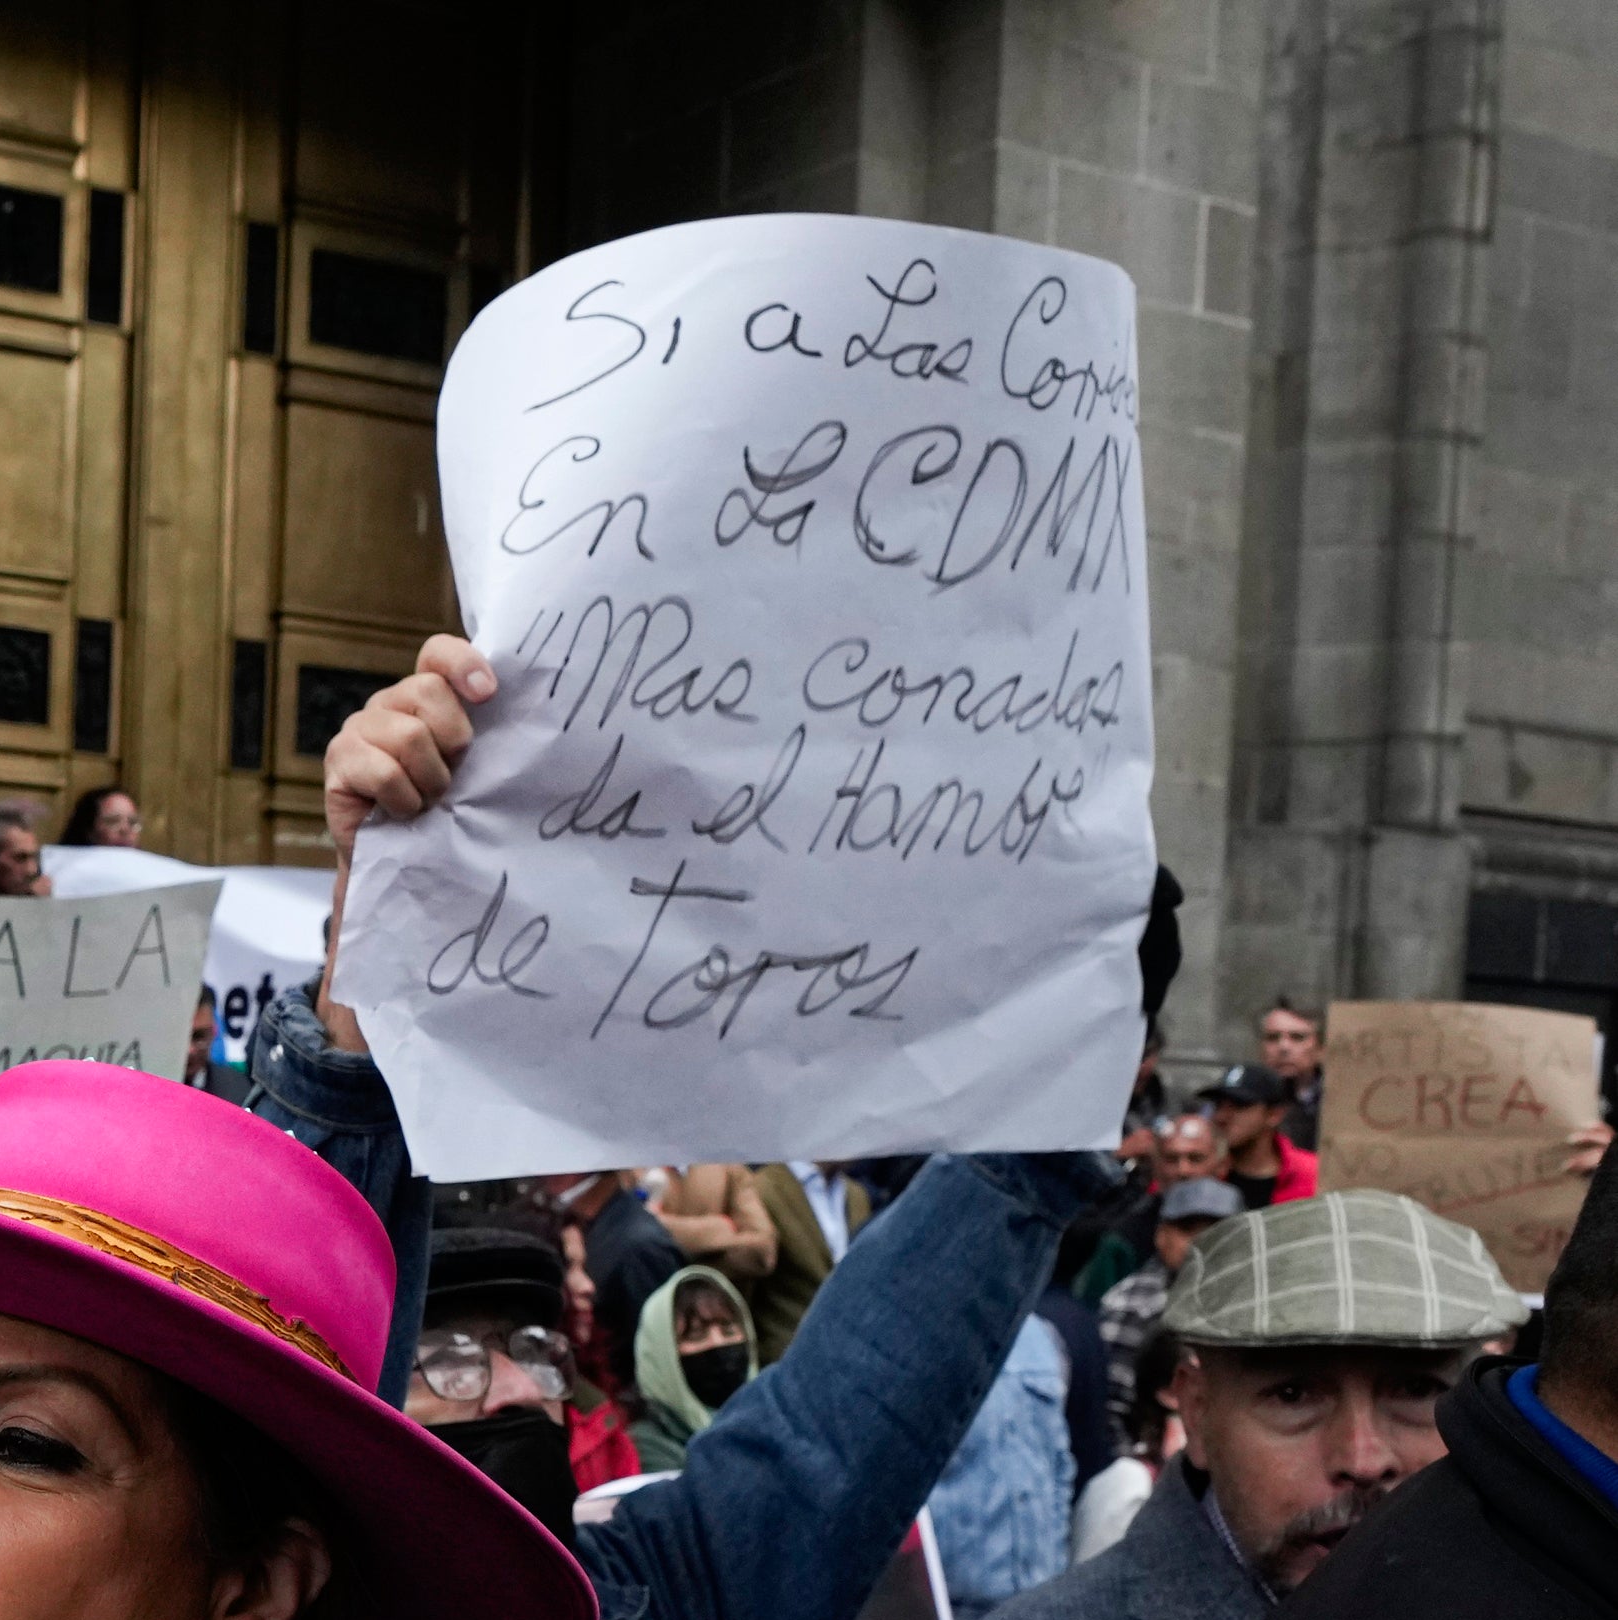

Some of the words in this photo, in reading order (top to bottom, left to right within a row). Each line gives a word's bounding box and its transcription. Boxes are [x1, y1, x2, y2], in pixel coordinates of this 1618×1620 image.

[63, 903, 171, 1000] LA
[426, 871, 554, 1000] de
[1358, 1073, 1550, 1132] CREA
